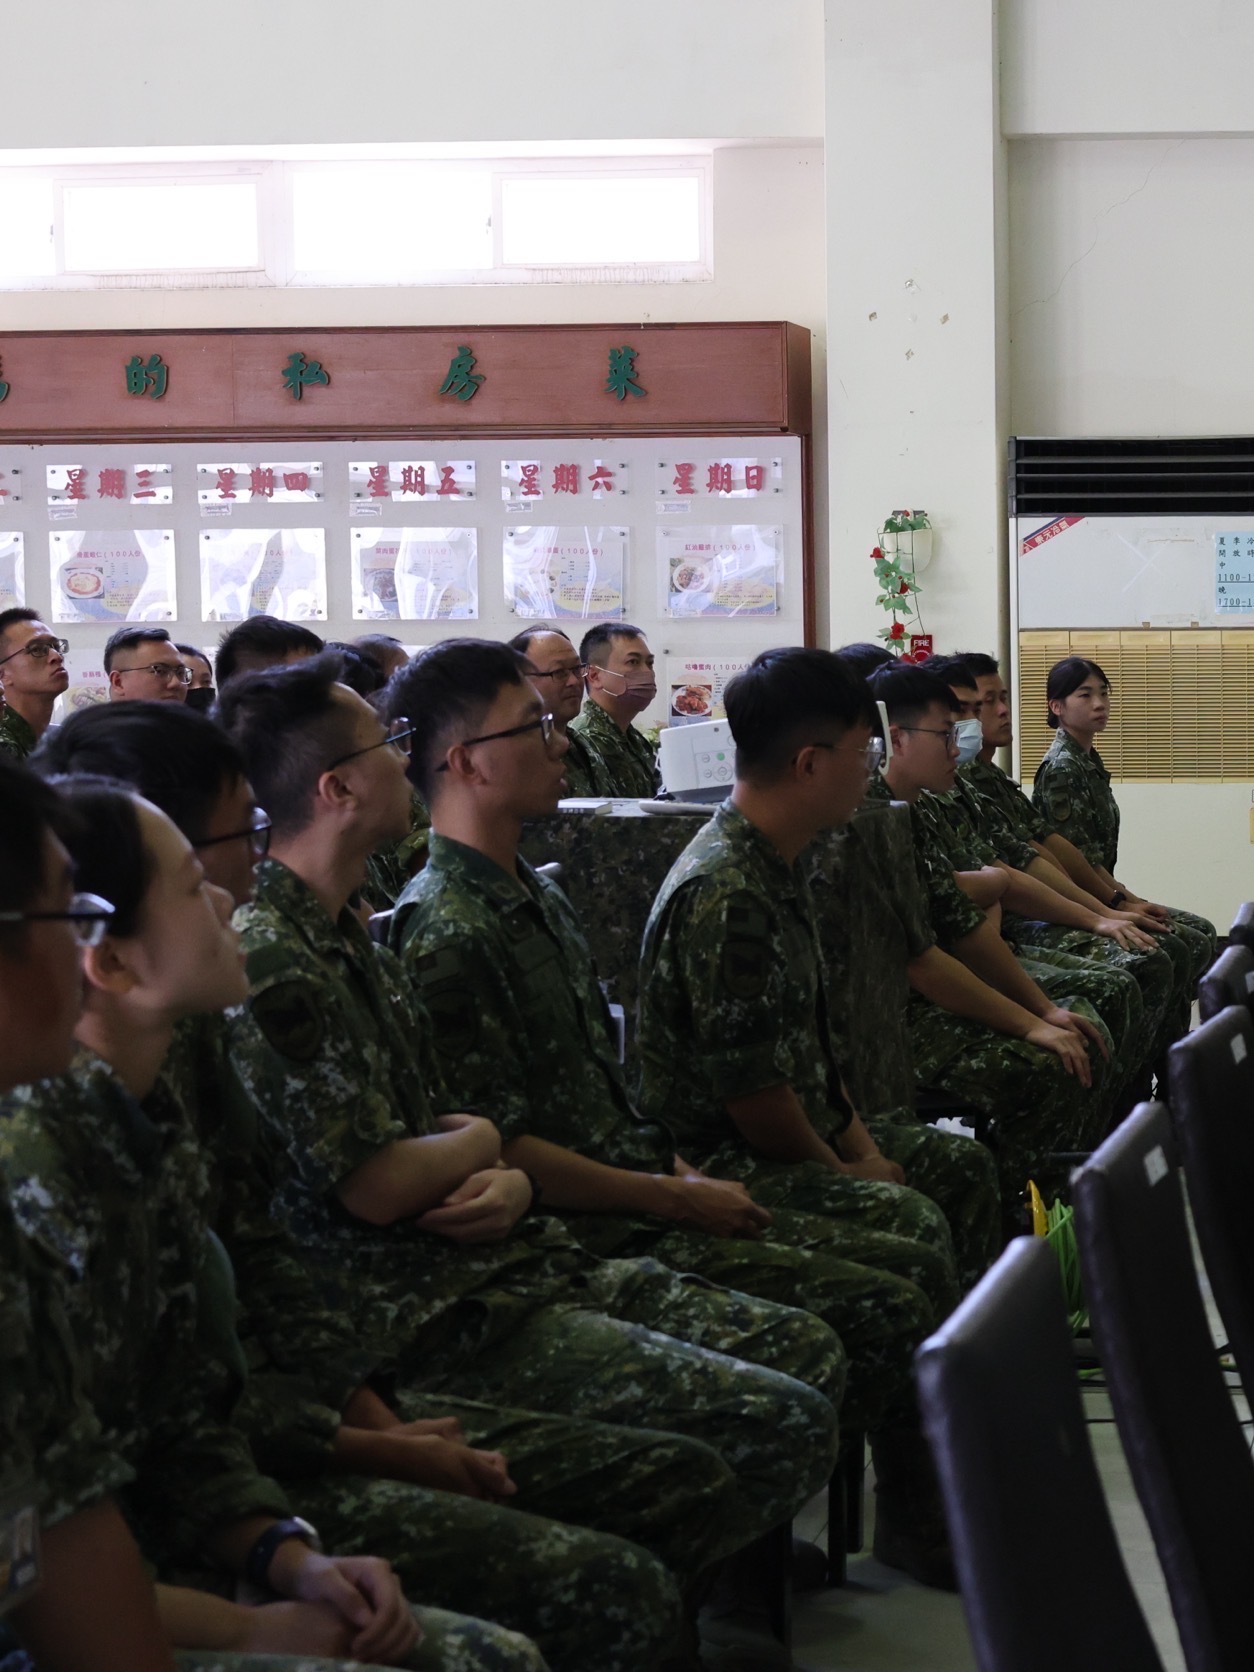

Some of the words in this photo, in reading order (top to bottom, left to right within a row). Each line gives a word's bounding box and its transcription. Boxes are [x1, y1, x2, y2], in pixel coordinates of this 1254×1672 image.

[64, 467, 157, 500] 星期三
[216, 467, 309, 499] 星期四
[367, 465, 460, 498] 星期五
[518, 464, 615, 497] 星期六
[673, 462, 765, 495] 星期日
[913, 639, 930, 647] FIRE
